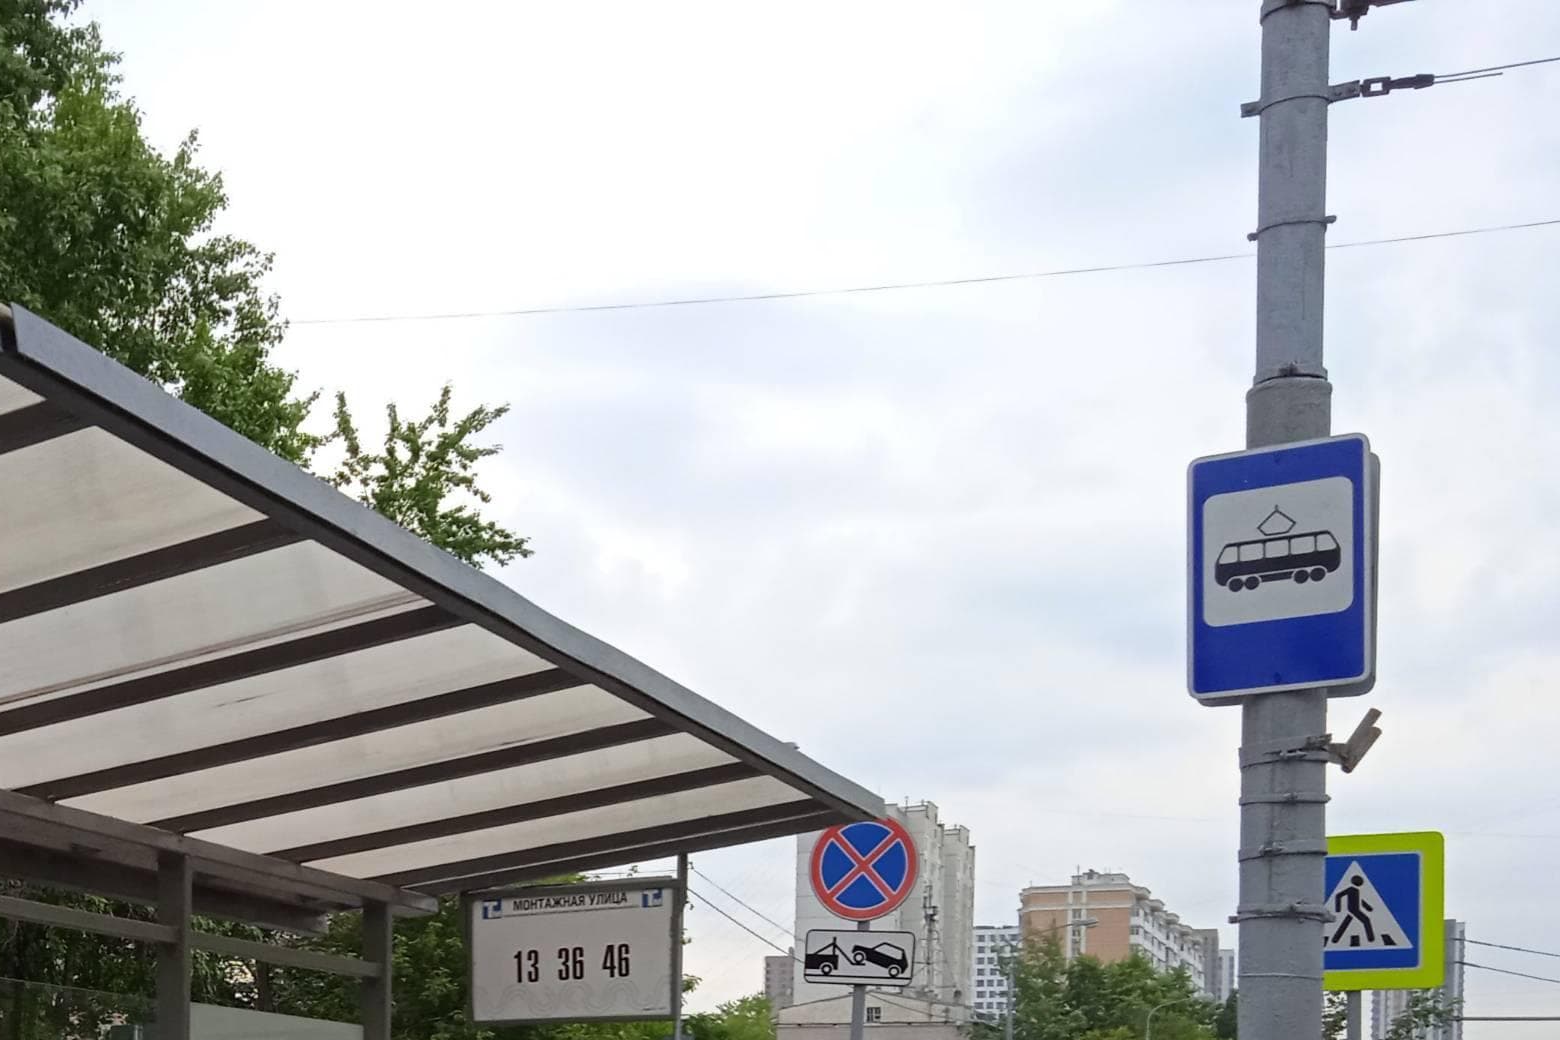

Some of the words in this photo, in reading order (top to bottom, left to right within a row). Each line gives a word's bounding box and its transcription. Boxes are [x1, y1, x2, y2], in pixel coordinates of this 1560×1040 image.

[513, 894, 585, 911] МОНТАЖНАЯ
[589, 891, 628, 905] УЛИЦА
[513, 950, 539, 983] 13
[557, 946, 584, 980] 36
[602, 943, 630, 978] 46
